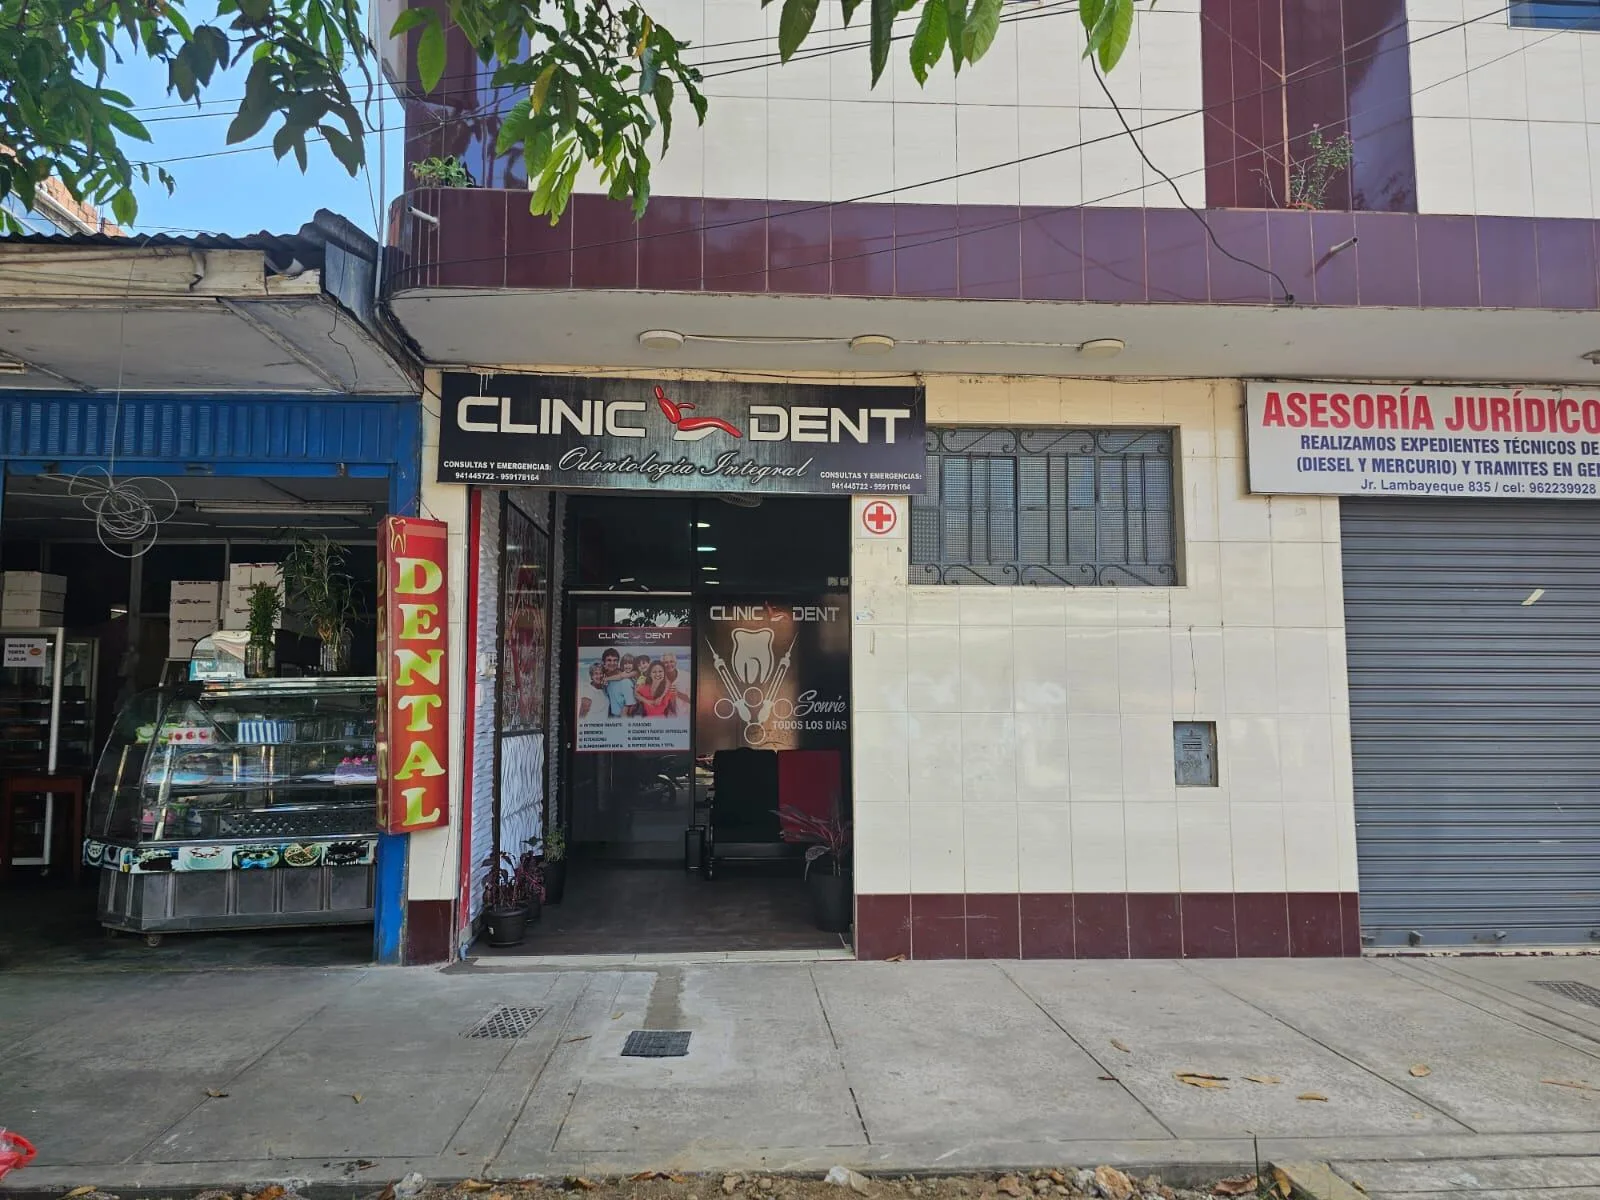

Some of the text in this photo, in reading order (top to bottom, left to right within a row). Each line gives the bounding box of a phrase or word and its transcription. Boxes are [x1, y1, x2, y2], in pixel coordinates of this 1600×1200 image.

[1262, 387, 1600, 434] ASESORÍA JURÍDICO
[457, 396, 911, 444] CLINIC DENT
[1301, 435, 1599, 455] REALIZAMOS EXPEDIENTES TÉCNICOS DE
[443, 461, 488, 469] CONSULTAS
[496, 462, 552, 471] EMERGENCIAS:
[558, 446, 814, 484] Odontología Integral
[1297, 457, 1354, 472] (DIESEL
[1358, 458, 1367, 472] Y
[1372, 459, 1457, 475] MERCURIO)
[1462, 461, 1471, 474] Y
[1475, 461, 1548, 476] TRAMITES
[1553, 463, 1572, 477] EN
[863, 472, 868, 480] Y
[1361, 479, 1596, 495] Jr. Lambayeque 835 / cel: 962239928
[710, 605, 840, 621] CLINIC DENT
[598, 632, 673, 640] CLINIC DENT
[394, 557, 445, 827] DENTAL
[773, 719, 847, 730] TODOS LOS DÍAS
